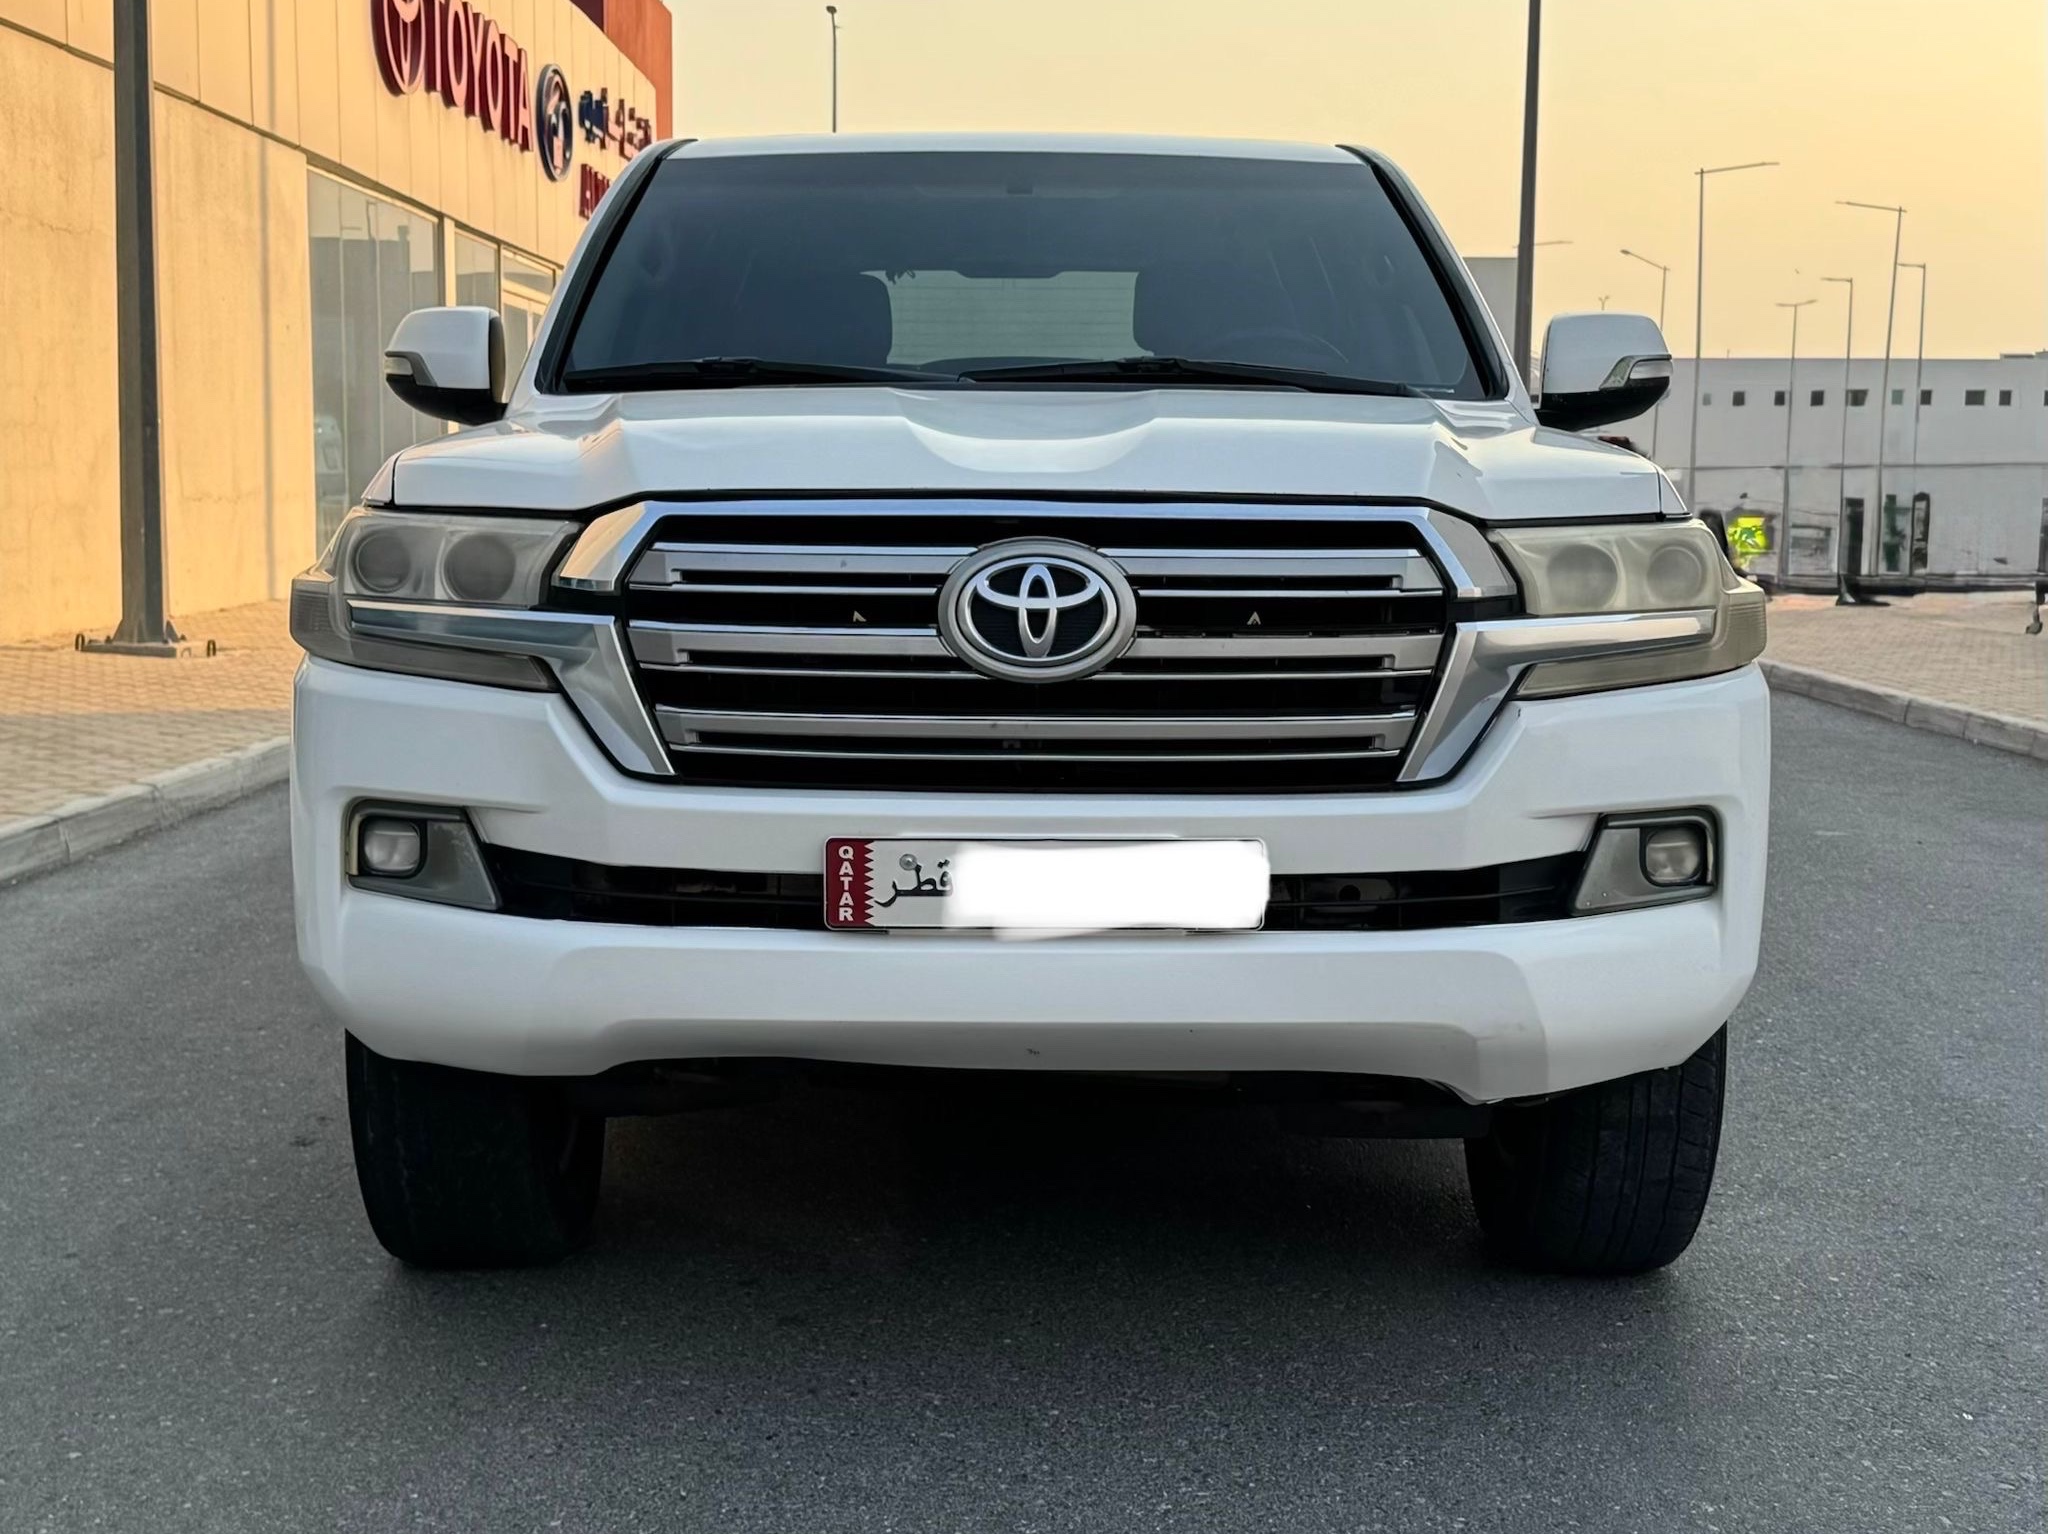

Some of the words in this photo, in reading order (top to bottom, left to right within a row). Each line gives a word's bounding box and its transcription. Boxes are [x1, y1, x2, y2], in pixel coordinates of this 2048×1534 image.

[424, 0, 533, 152] TOYOTA
[838, 845, 855, 921] QATAR
[874, 859, 953, 908] قطر
